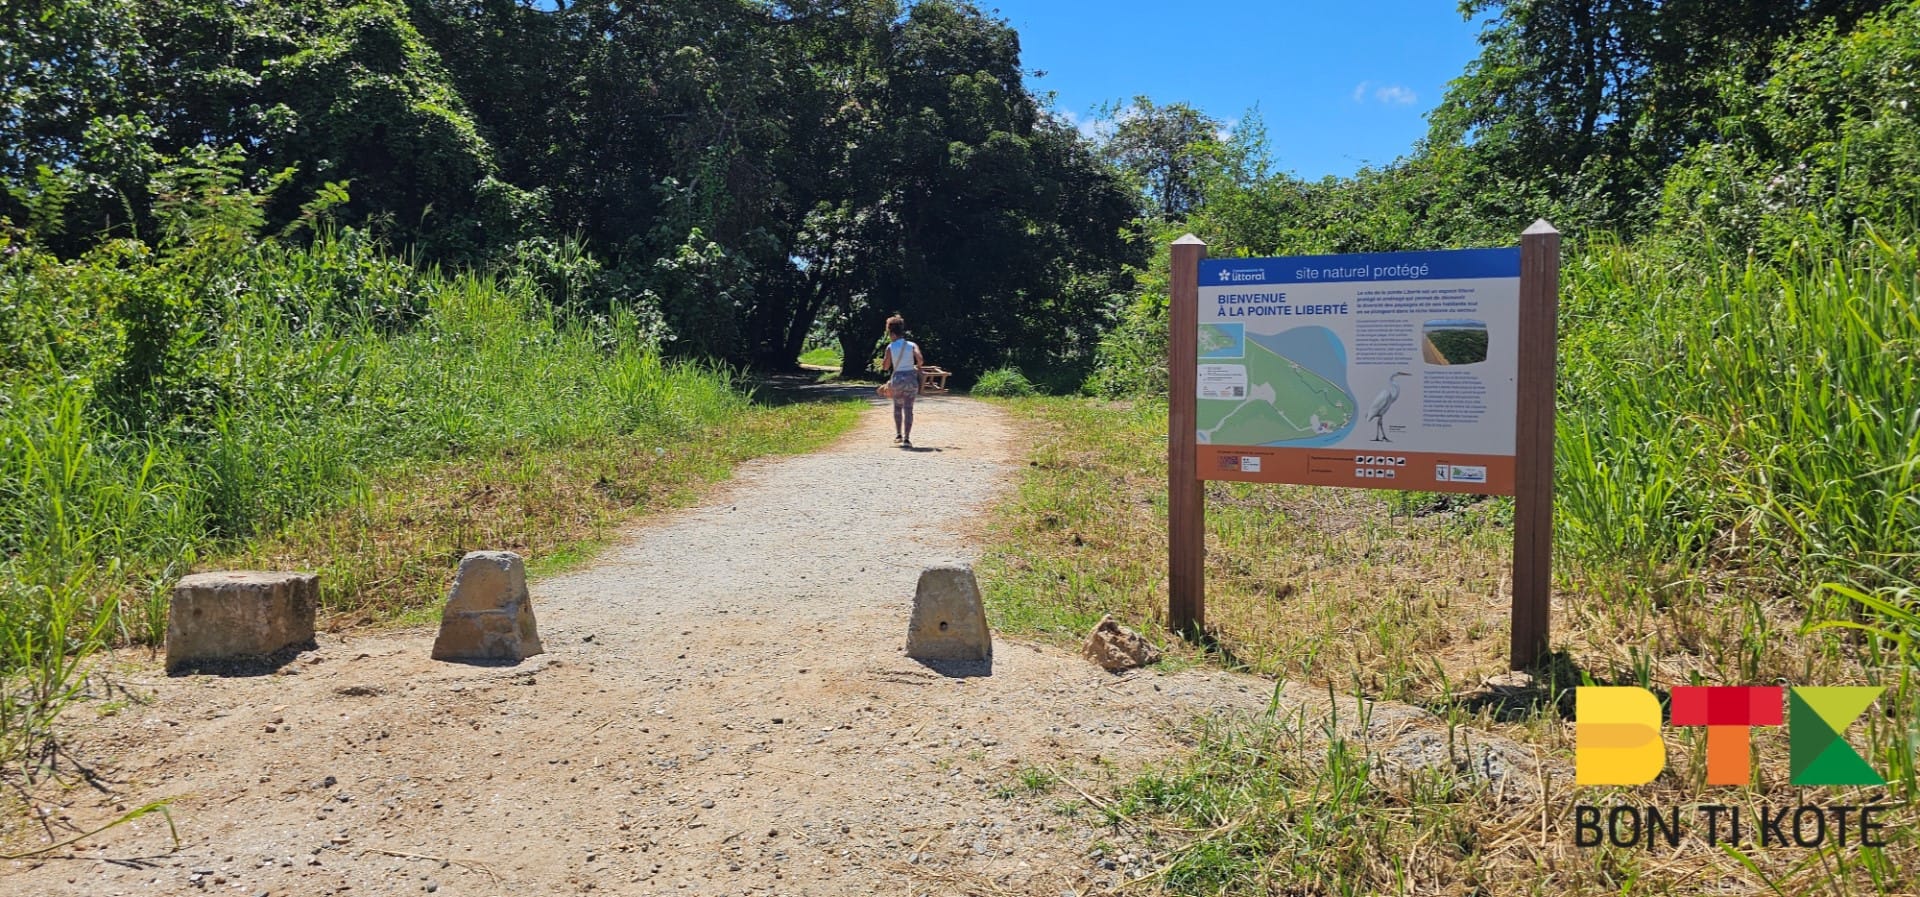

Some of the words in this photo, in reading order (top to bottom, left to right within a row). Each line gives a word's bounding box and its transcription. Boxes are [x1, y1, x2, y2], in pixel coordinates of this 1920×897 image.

[1232, 271, 1266, 281] littoral
[1296, 267, 1319, 279] site
[1323, 265, 1369, 279] naturel
[1373, 263, 1429, 279] protégé
[1217, 293, 1287, 304] BIENVENUE
[1217, 304, 1226, 317] À
[1229, 306, 1244, 317] LA
[1247, 305, 1292, 316] POINTE
[1295, 301, 1348, 315] LIBERTÉ
